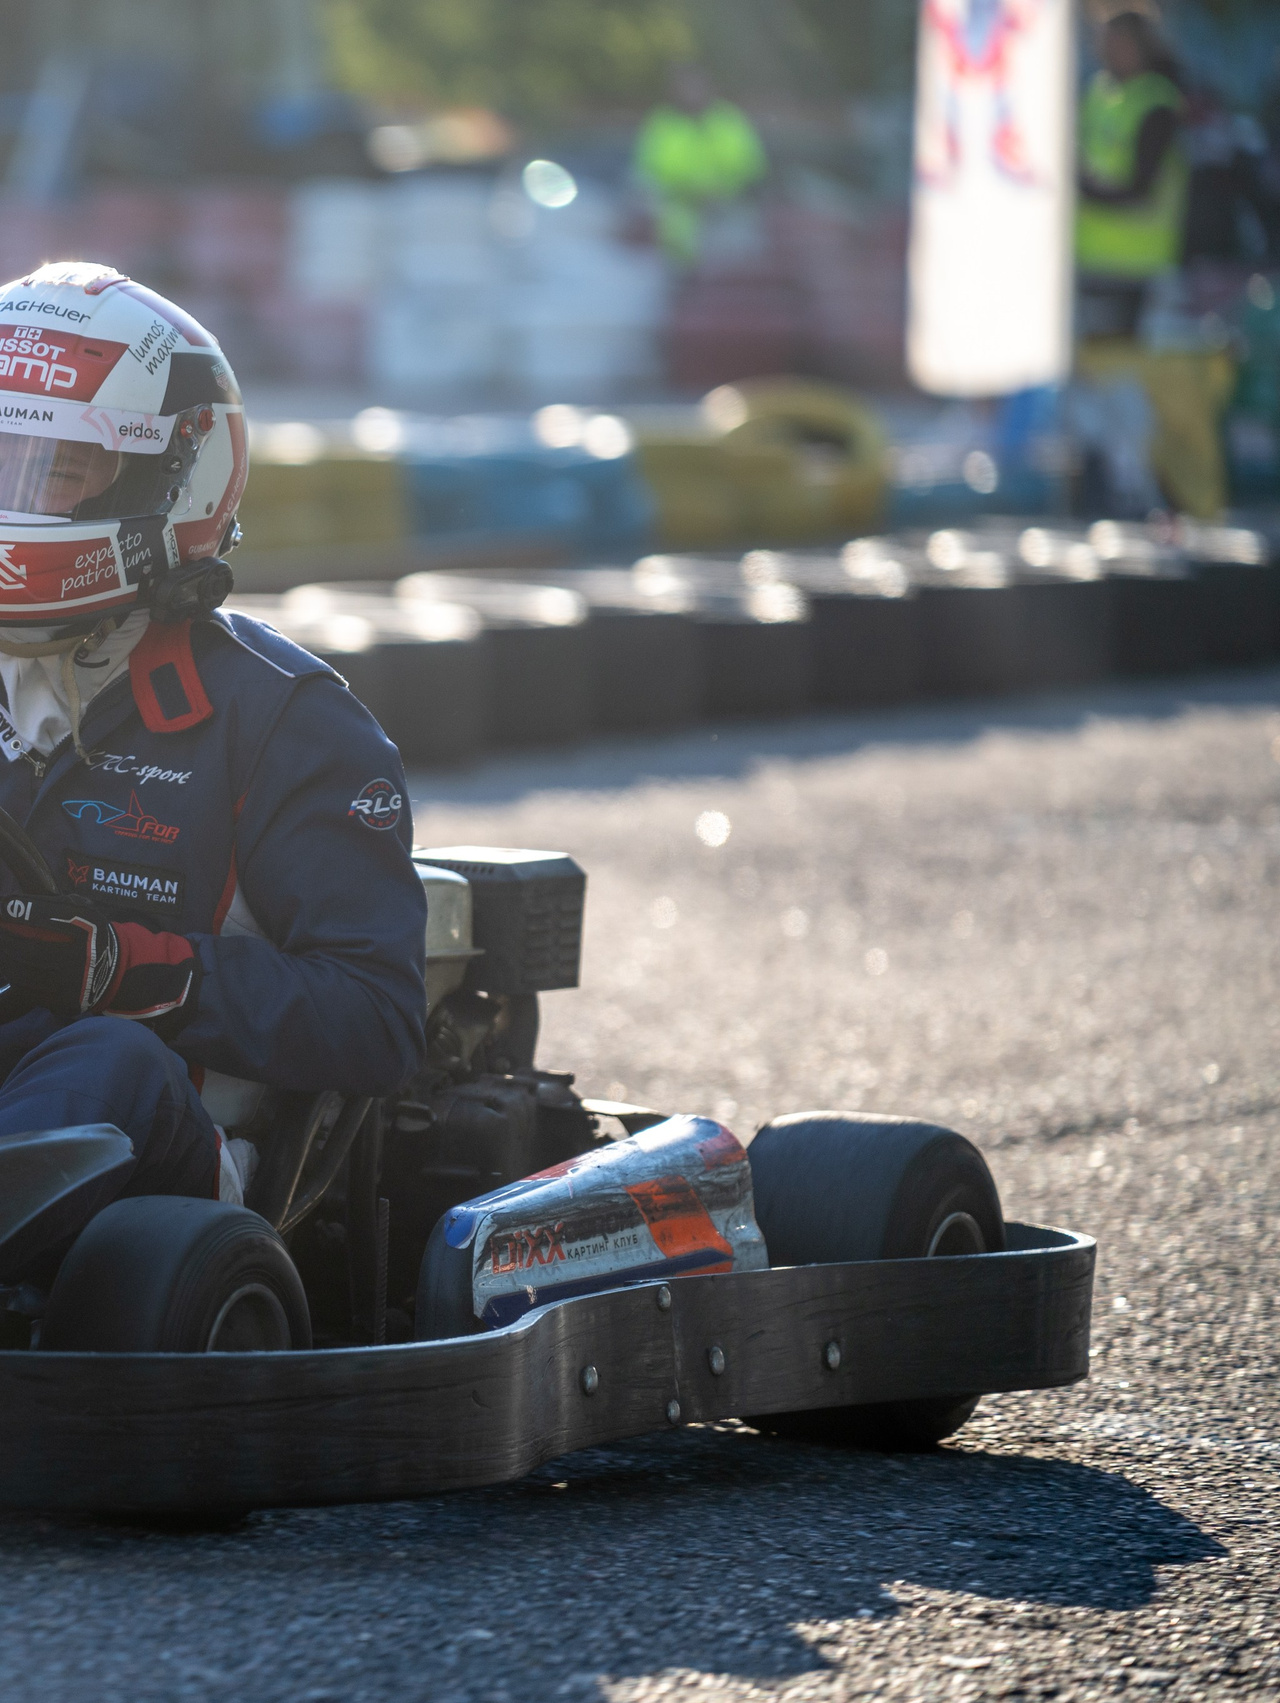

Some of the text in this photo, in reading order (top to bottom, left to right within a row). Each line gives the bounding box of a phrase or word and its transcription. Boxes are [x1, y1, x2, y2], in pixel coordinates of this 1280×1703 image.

[127, 319, 165, 363] lumos
[74, 532, 142, 569] expecto
[349, 794, 402, 815] RLG
[92, 882, 176, 904] KARTING TEAM
[93, 867, 179, 895] BAUMAN
[567, 1234, 639, 1259] КАРТИНГ КЛУБ
